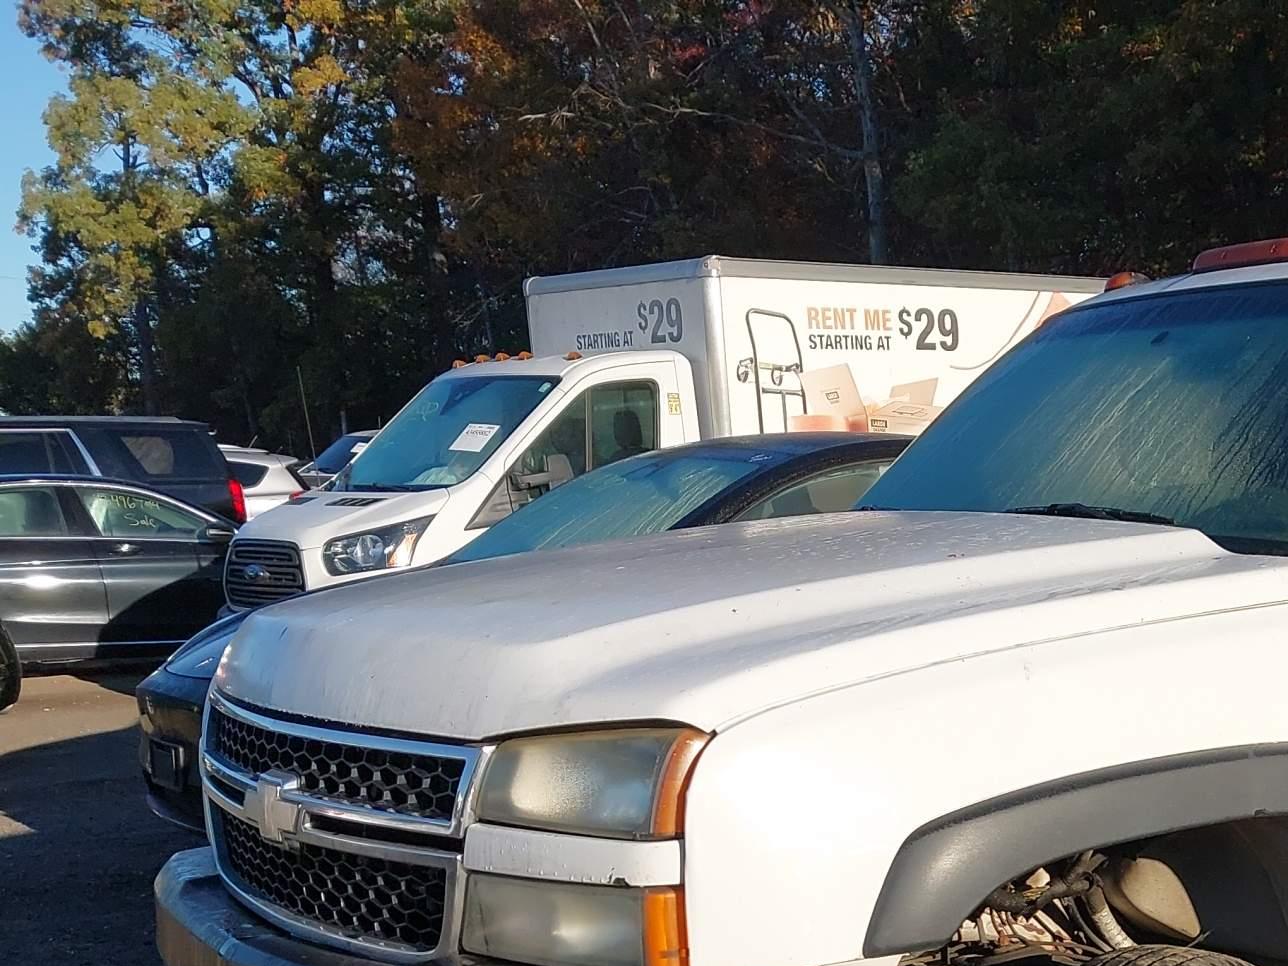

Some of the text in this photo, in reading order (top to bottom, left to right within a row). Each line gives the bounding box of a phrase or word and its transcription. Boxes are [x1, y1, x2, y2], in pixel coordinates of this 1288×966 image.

[637, 297, 683, 344] $29
[806, 306, 893, 331] RENT ME
[898, 306, 960, 352] $29
[576, 330, 634, 351] STARTING AT
[808, 334, 892, 351] STARTING AT
